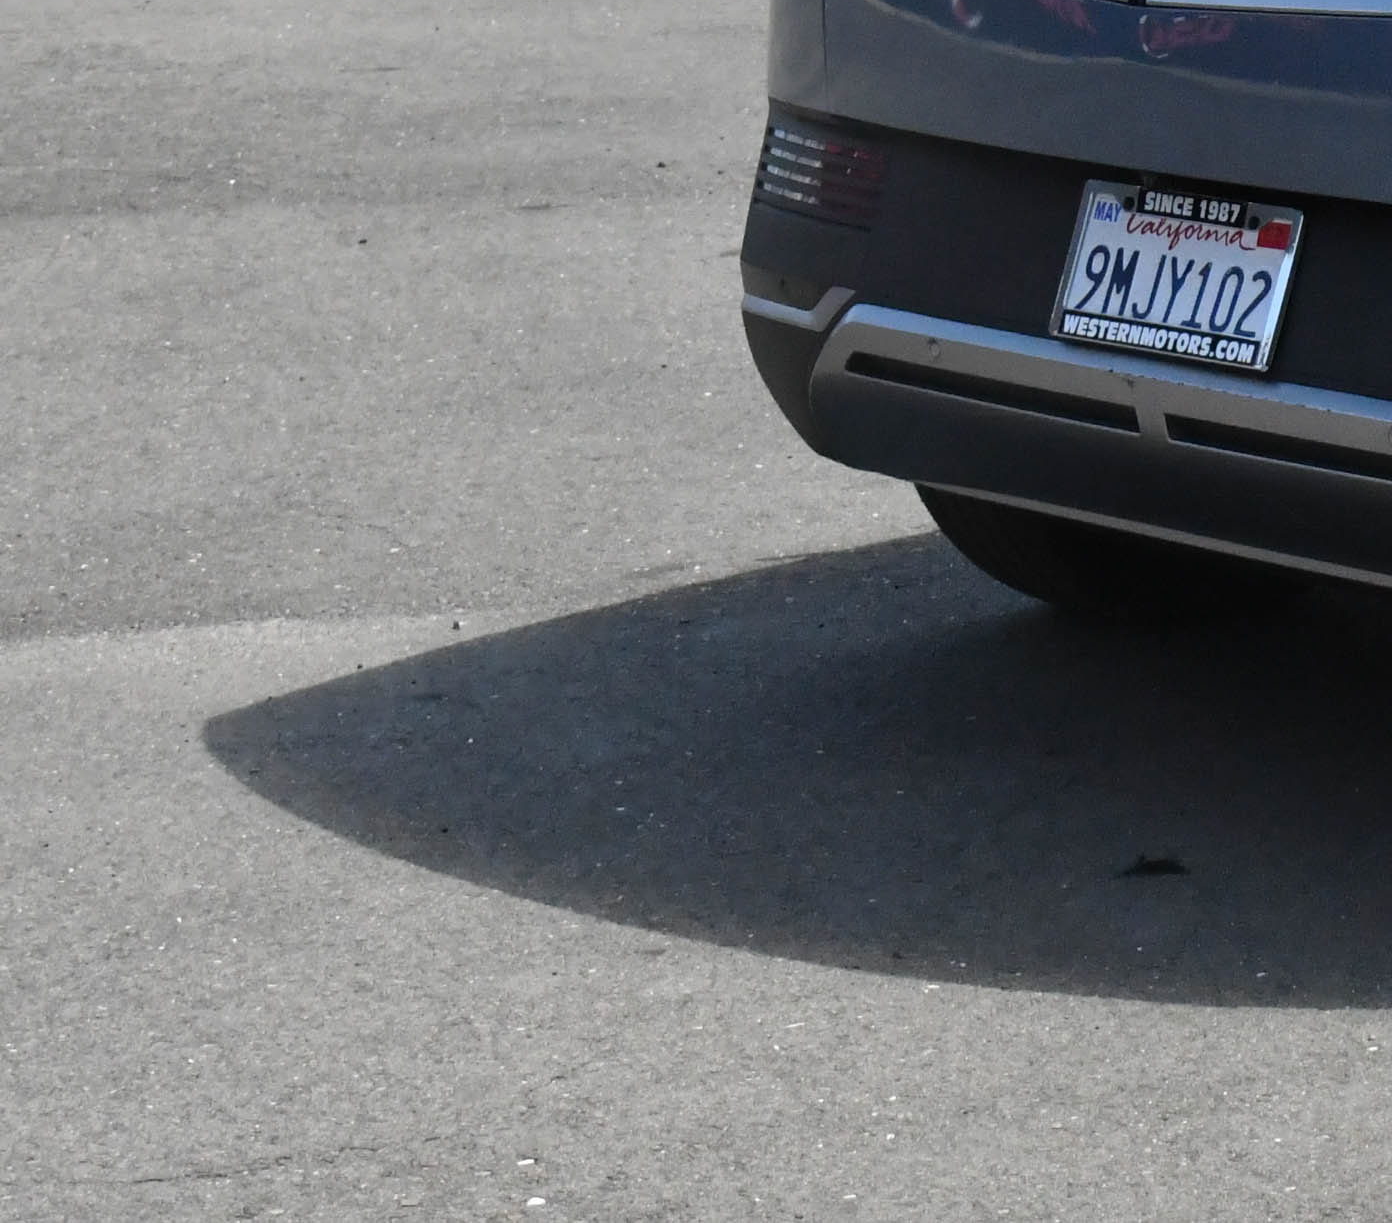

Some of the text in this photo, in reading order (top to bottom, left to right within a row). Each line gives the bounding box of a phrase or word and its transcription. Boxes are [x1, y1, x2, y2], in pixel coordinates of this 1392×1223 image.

[1093, 200, 1122, 223] MAY
[1144, 191, 1241, 223] SINCE 1987
[1126, 213, 1256, 250] California
[1074, 244, 1272, 338] 9MJY102
[1064, 314, 1255, 364] WESTERNMOTORS.COM
